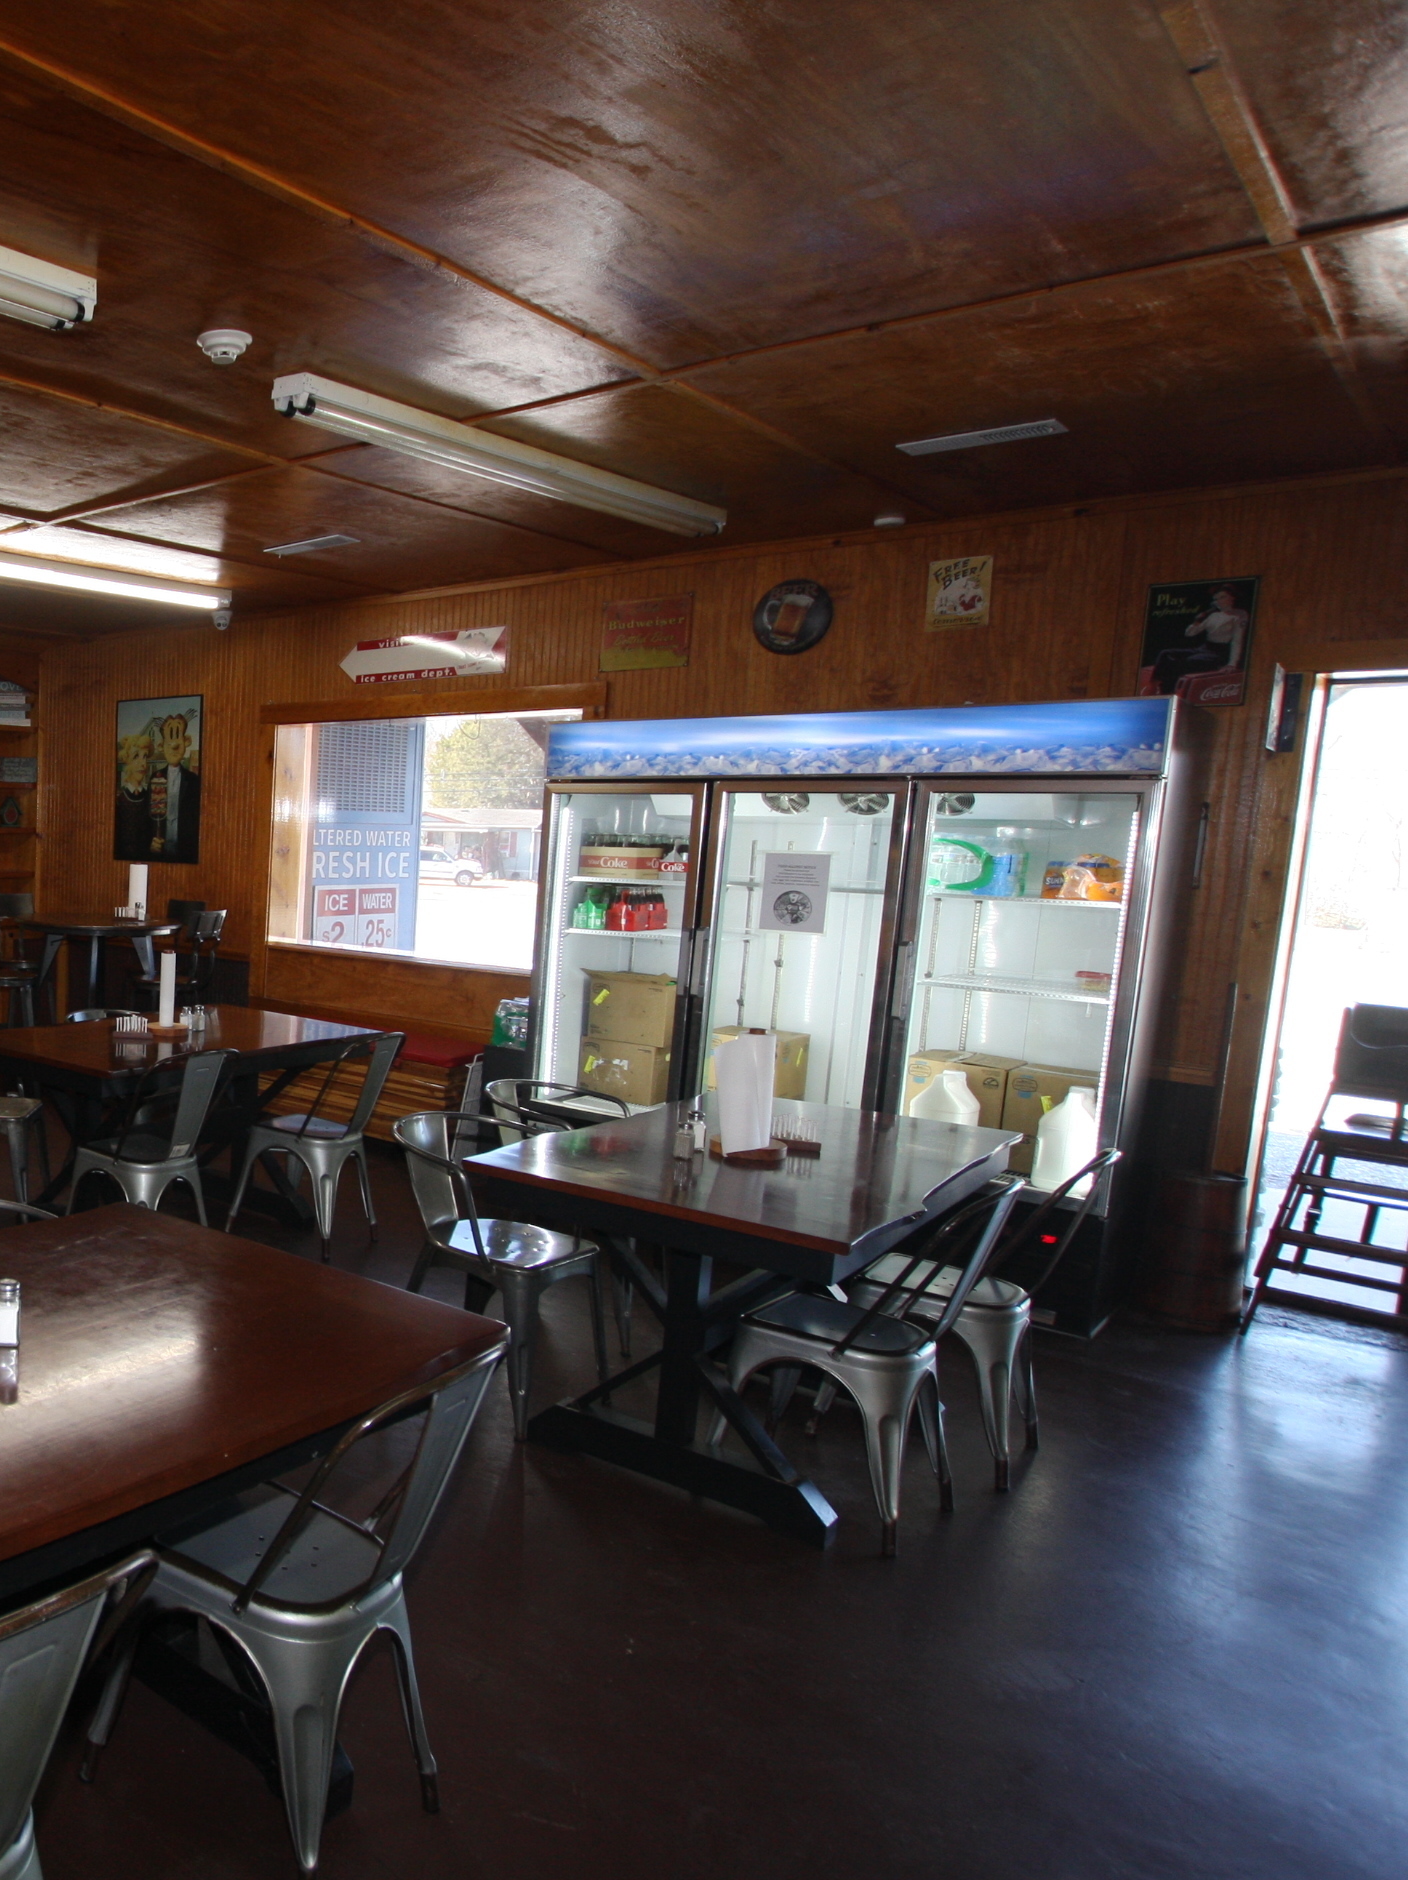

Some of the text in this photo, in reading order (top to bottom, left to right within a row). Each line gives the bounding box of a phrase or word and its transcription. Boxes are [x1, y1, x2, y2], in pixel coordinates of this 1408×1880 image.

[934, 559, 970, 584] FREE
[770, 583, 819, 600] BEER
[1155, 593, 1187, 607] Play
[608, 616, 686, 631] Budweiser
[360, 667, 453, 683] ice cream dept.
[313, 829, 411, 847] LTERED WATER
[312, 851, 410, 879] RESH ICE
[600, 856, 629, 868] Coke
[661, 862, 685, 872] Coke
[325, 894, 348, 911] ICE
[362, 893, 392, 909] WATER
